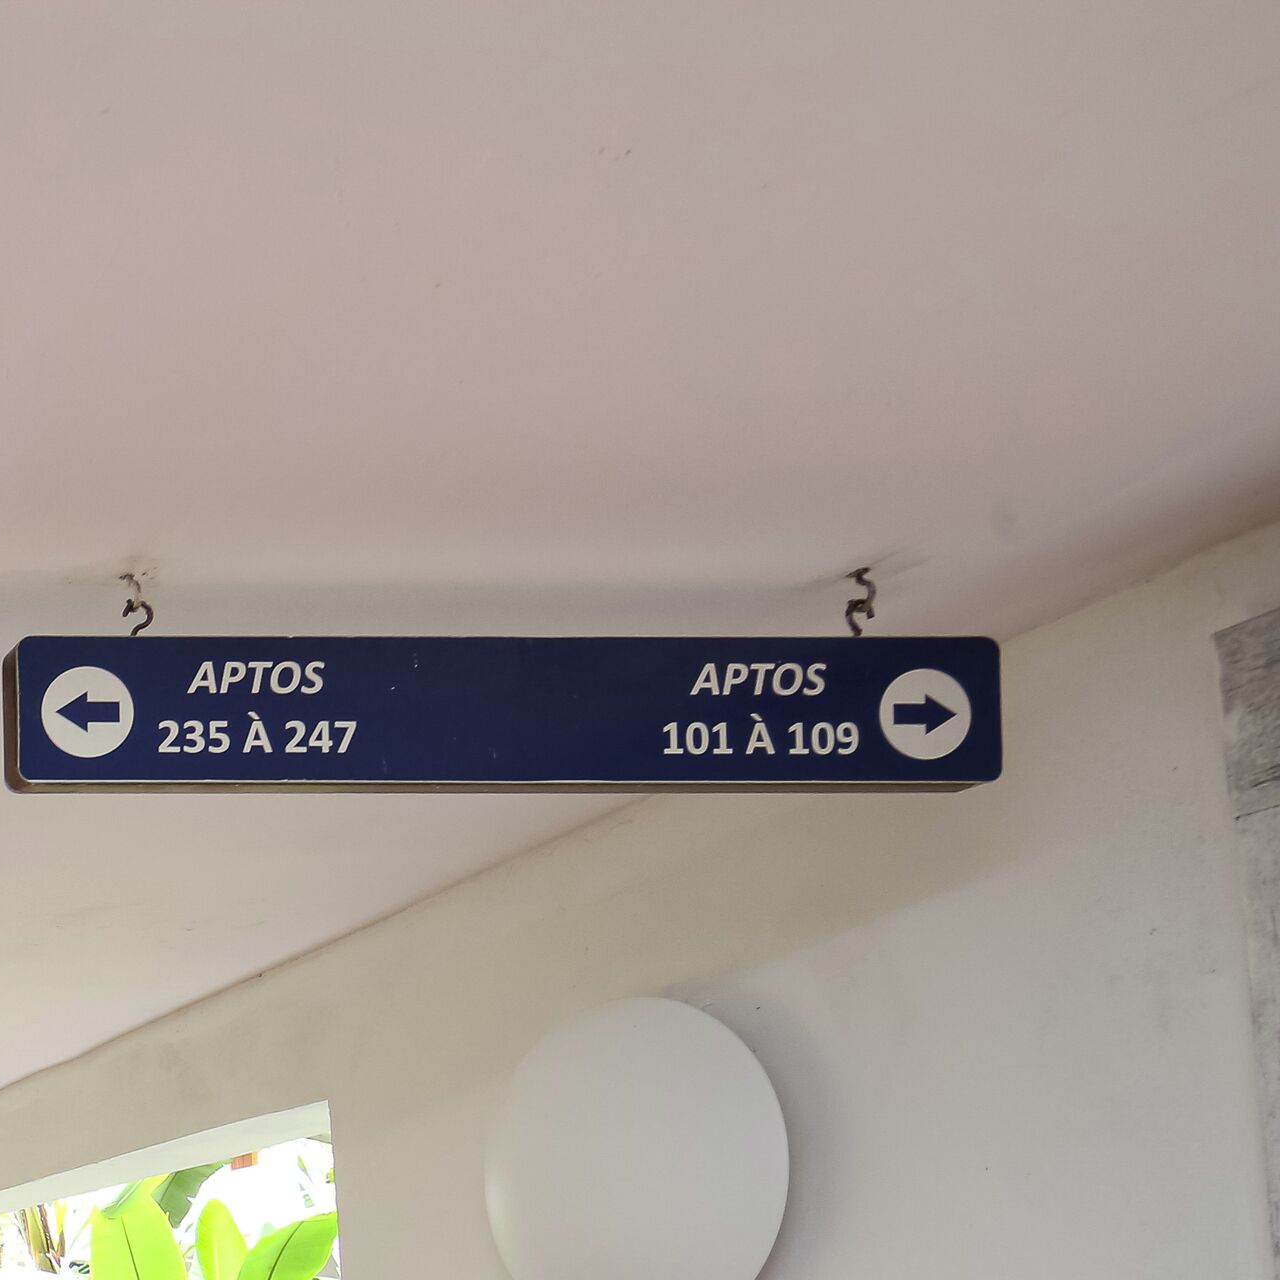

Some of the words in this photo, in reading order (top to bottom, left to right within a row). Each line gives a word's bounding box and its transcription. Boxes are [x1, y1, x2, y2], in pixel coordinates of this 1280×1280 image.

[186, 661, 325, 694] APTOS
[690, 663, 827, 696] APTOS
[158, 720, 231, 754] 235
[242, 711, 273, 753] À
[284, 720, 357, 754] 247
[663, 721, 733, 755] 101
[745, 713, 776, 755] À
[788, 722, 859, 755] 109
